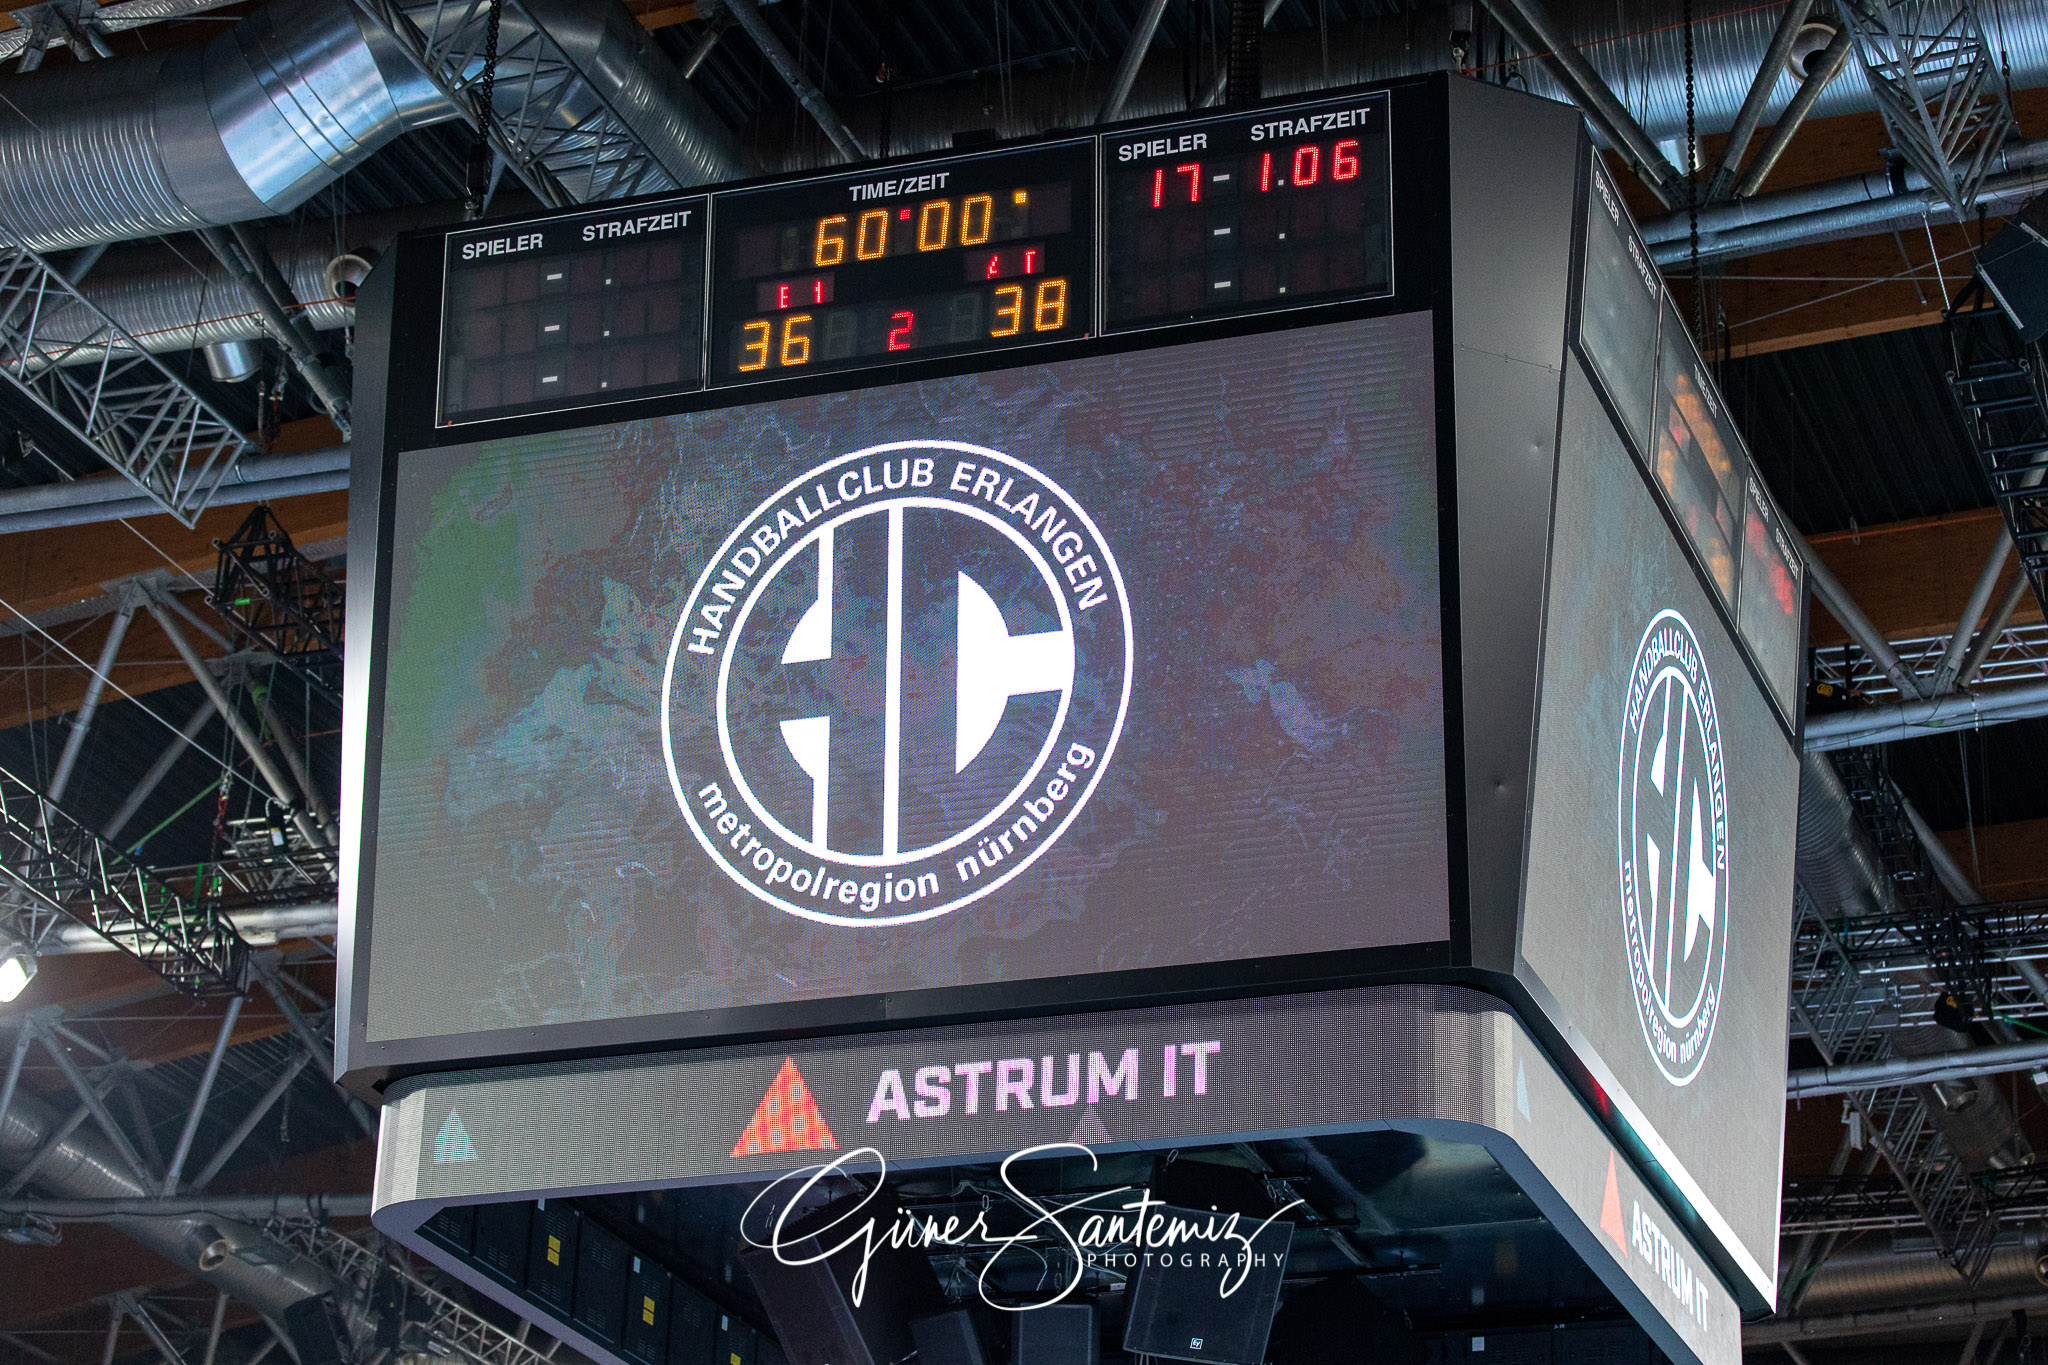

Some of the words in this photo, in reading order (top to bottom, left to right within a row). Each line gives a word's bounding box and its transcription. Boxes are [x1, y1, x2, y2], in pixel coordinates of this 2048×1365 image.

[1118, 133, 1208, 162] SPIELER
[1250, 107, 1371, 142] STRAFZEIT
[848, 172, 951, 202] TIME/ZEIT
[1595, 170, 1620, 227] SPIELER
[461, 232, 544, 260] SPIELER
[581, 209, 692, 242] STRAFZEIT
[888, 310, 914, 351] 2
[991, 279, 1067, 337] 38
[738, 315, 813, 372] 36
[687, 458, 934, 656] HANDBALLCLUB
[949, 460, 1108, 611] ERLANGEN
[1629, 627, 1698, 734] HANDBALLCLUB
[1698, 679, 1725, 871] ERLANGEN
[698, 781, 940, 912] metropolregion
[955, 742, 1096, 883] nürnberg
[1623, 860, 1677, 1065] metropolregion
[866, 1048, 1139, 1124] ASTRUM
[1163, 1040, 1221, 1097] IT
[1632, 1200, 1693, 1315] ASTRUM
[1695, 1276, 1709, 1333] IT
